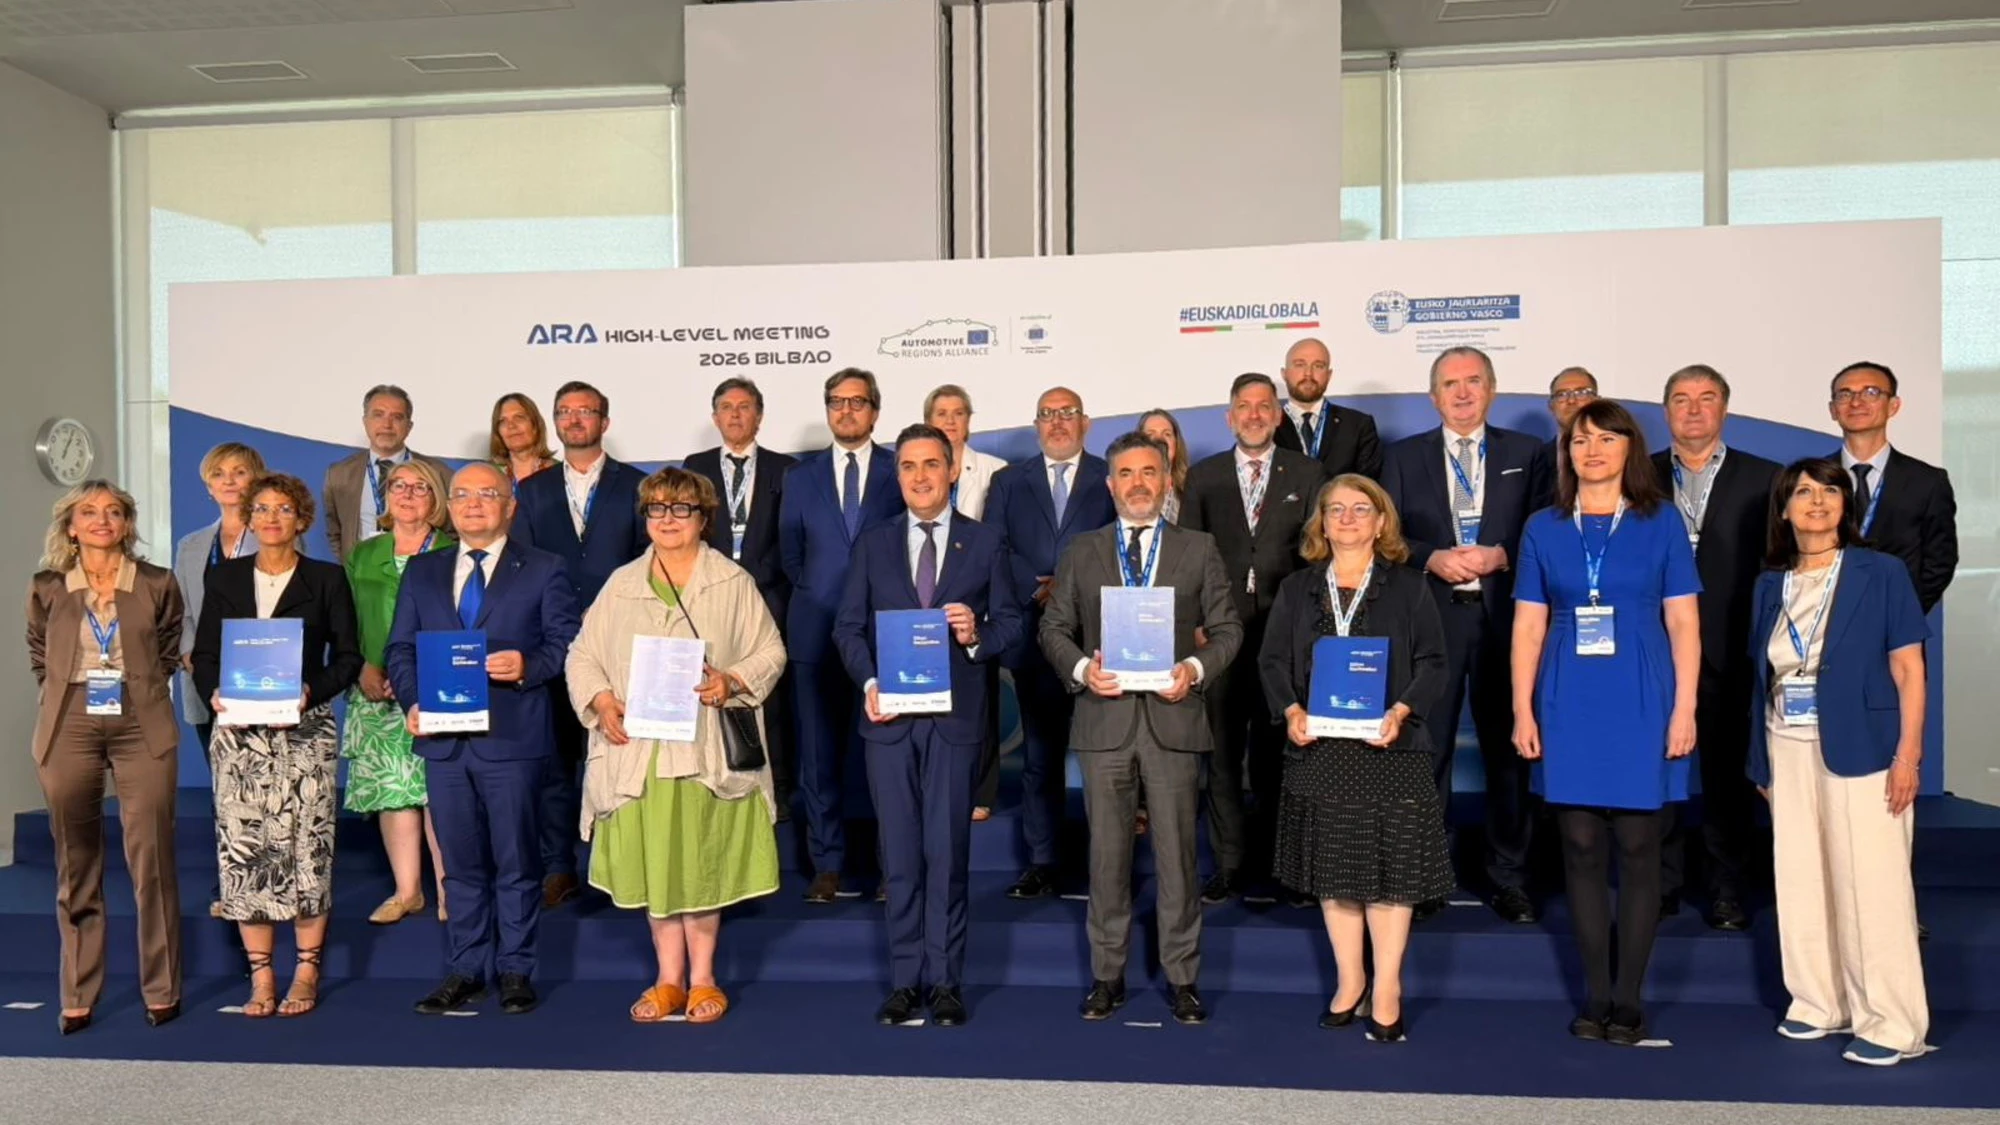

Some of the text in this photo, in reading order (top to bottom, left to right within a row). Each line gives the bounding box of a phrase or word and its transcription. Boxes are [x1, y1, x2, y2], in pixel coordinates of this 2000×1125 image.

[1415, 297, 1511, 310] EUSKO JAURLARITZA
[1180, 302, 1319, 322] #EUSKADIGLOBALA
[1415, 309, 1504, 321] GOBIERNO VASCO
[526, 322, 830, 345] ARA HIGH-LEVEL MEETING
[901, 338, 965, 347] AUTOMOTIVE
[699, 350, 832, 366] 2026 BILBAO
[901, 348, 990, 358] REGIONS ALLIANCE
